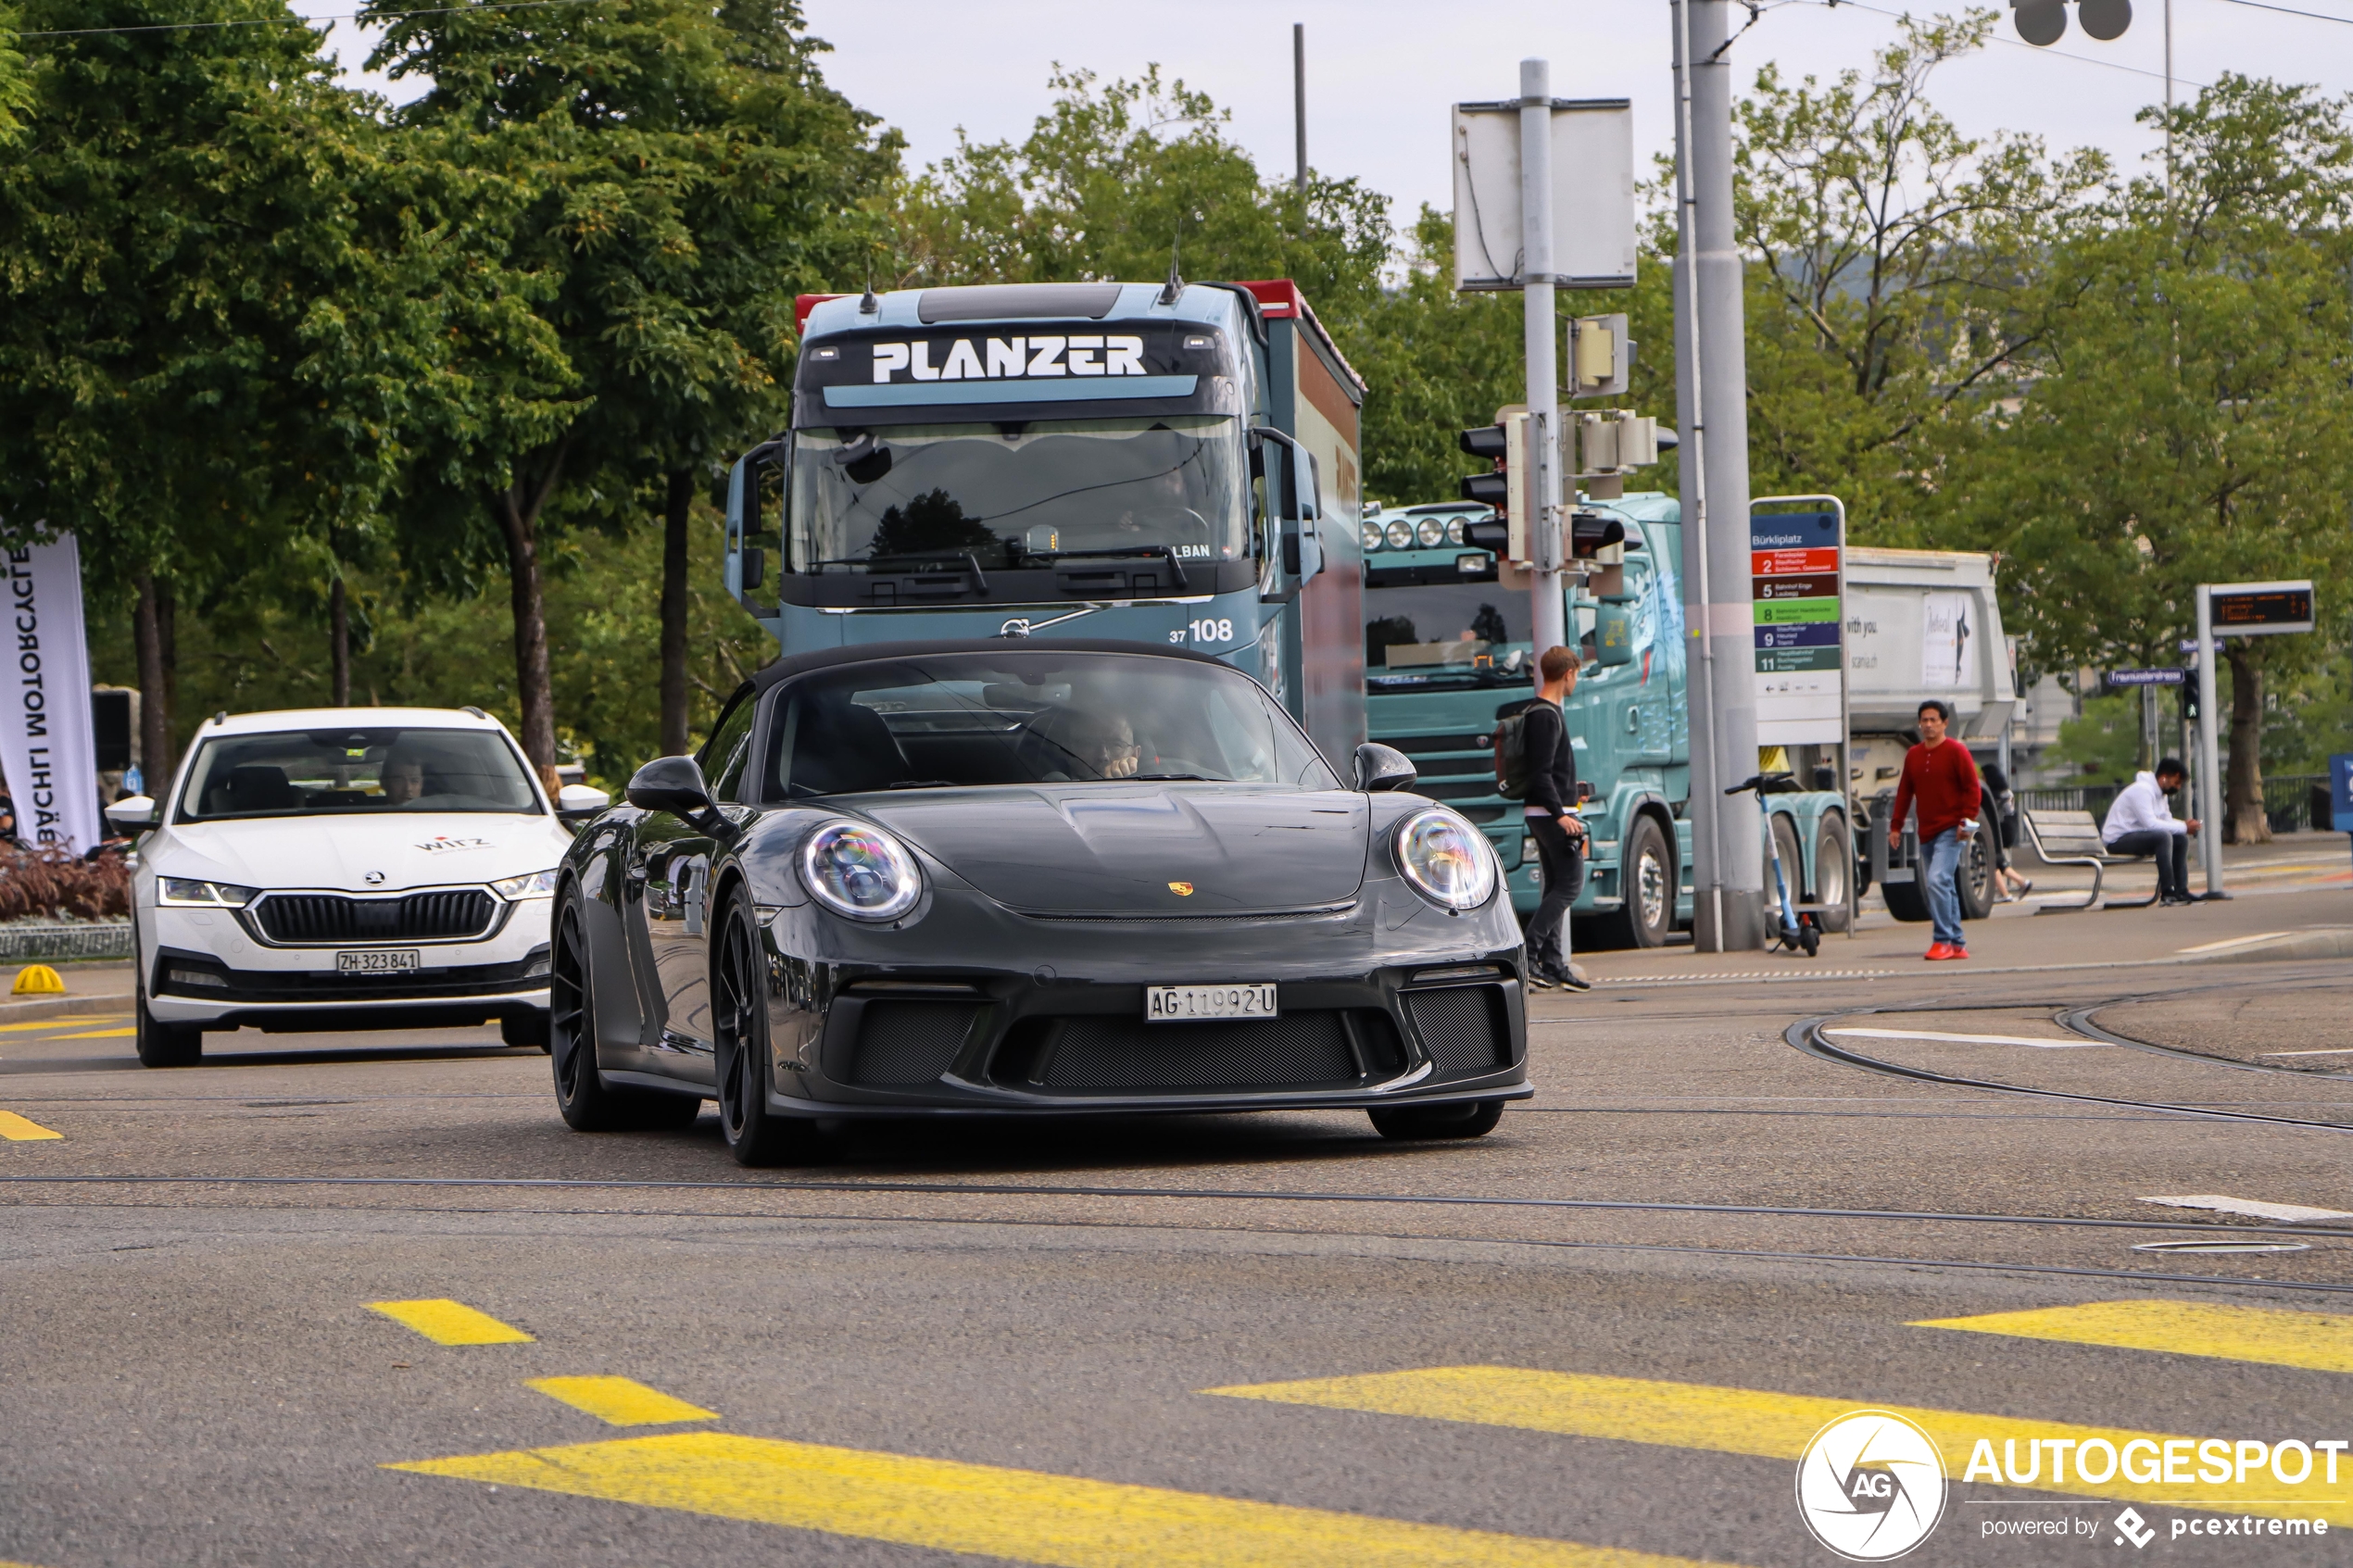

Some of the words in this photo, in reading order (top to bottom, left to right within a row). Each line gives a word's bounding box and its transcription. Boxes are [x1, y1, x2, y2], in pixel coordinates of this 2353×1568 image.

[874, 335, 1148, 383] PLANZER
[1752, 534, 1803, 546] Bürkliplatz
[1164, 544, 1210, 558] LBAN
[1763, 559, 1772, 573] 2
[1763, 584, 1773, 598] 5
[1764, 608, 1773, 621] 8
[1169, 630, 1186, 643] 37
[1189, 619, 1234, 642] 108
[1764, 633, 1774, 646] 9
[1761, 658, 1774, 671] 11
[413, 836, 490, 851] wirz
